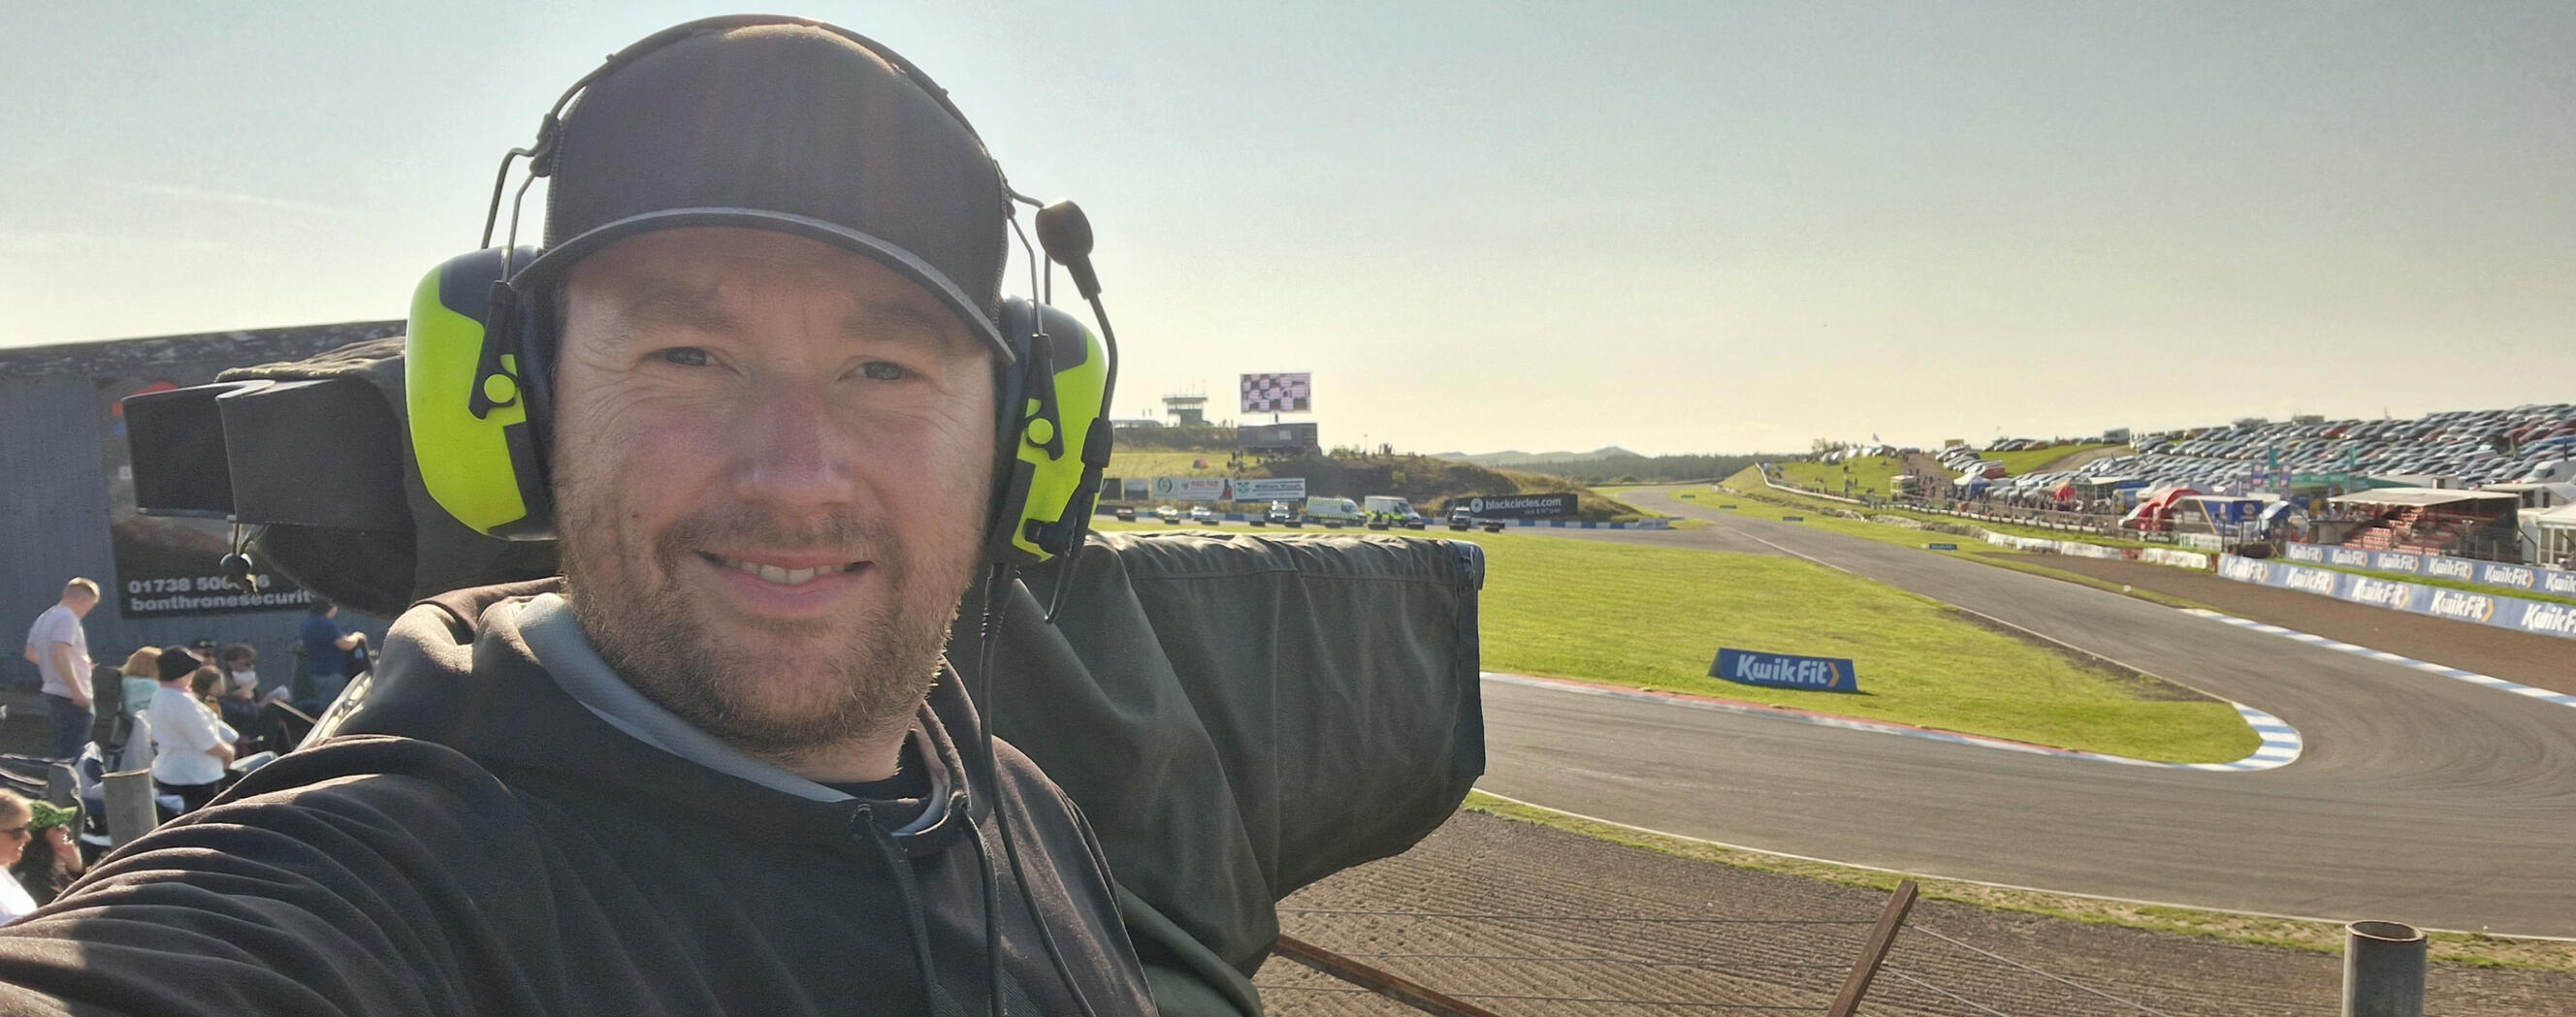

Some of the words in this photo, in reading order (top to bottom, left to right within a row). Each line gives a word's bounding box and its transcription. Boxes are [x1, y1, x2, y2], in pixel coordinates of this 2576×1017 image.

[1485, 497, 1562, 510] blackcircles.com
[2429, 557, 2469, 577] KwikFit
[2484, 564, 2529, 587] KwikFit
[128, 577, 191, 594] 01738
[2351, 578, 2403, 605] KwikFit
[131, 588, 311, 611] bonthronesecurit
[2430, 589, 2487, 620] KwikFit
[2522, 603, 2576, 634] KwikF
[1736, 653, 1829, 684] KwikFit
